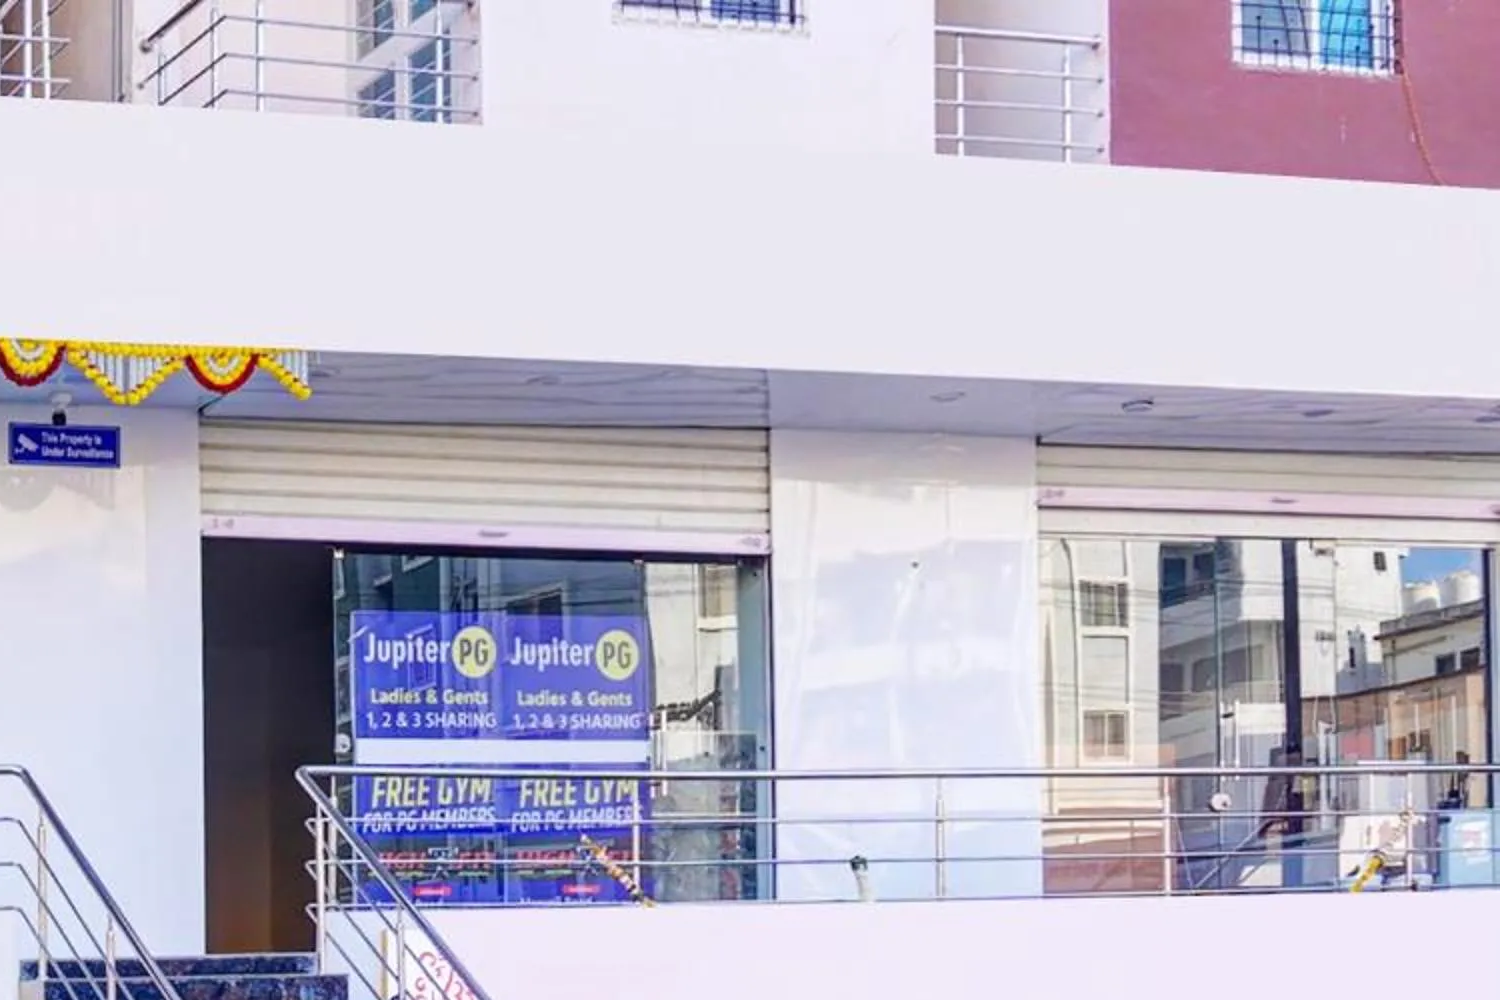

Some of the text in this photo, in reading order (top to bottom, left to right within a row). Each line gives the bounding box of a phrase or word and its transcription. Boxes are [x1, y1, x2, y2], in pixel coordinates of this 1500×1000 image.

[363, 632, 489, 670] Jupiter PG
[510, 635, 633, 673] Jupiter PG
[371, 687, 489, 705] Ladies & Gents
[516, 689, 633, 707] Ladies & Gents
[382, 711, 392, 728] 2
[395, 711, 408, 728] &
[411, 711, 422, 728] 3
[424, 711, 498, 729] SHARING
[569, 713, 641, 730] SHARING
[372, 776, 493, 809] FREE GYM
[520, 779, 577, 809] FREE
[362, 811, 393, 834] FOR
[396, 810, 418, 832] PG
[511, 812, 542, 834] FOR
